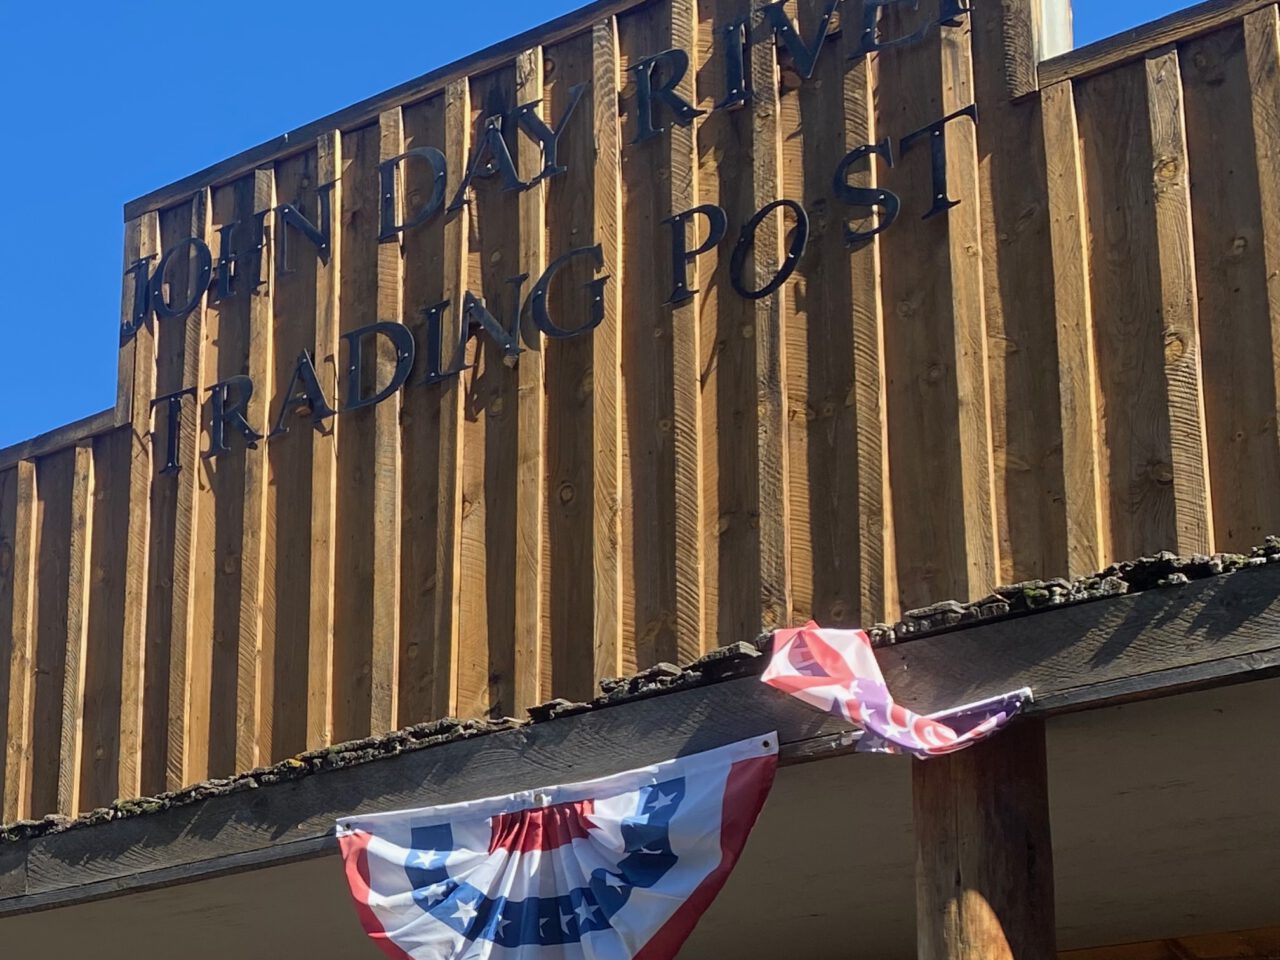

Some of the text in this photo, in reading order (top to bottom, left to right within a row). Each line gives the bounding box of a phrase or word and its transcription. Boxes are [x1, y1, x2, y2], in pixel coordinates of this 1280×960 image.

[121, 0, 973, 337] JOHN DAY RIVE
[151, 103, 979, 478] TRADING POST
